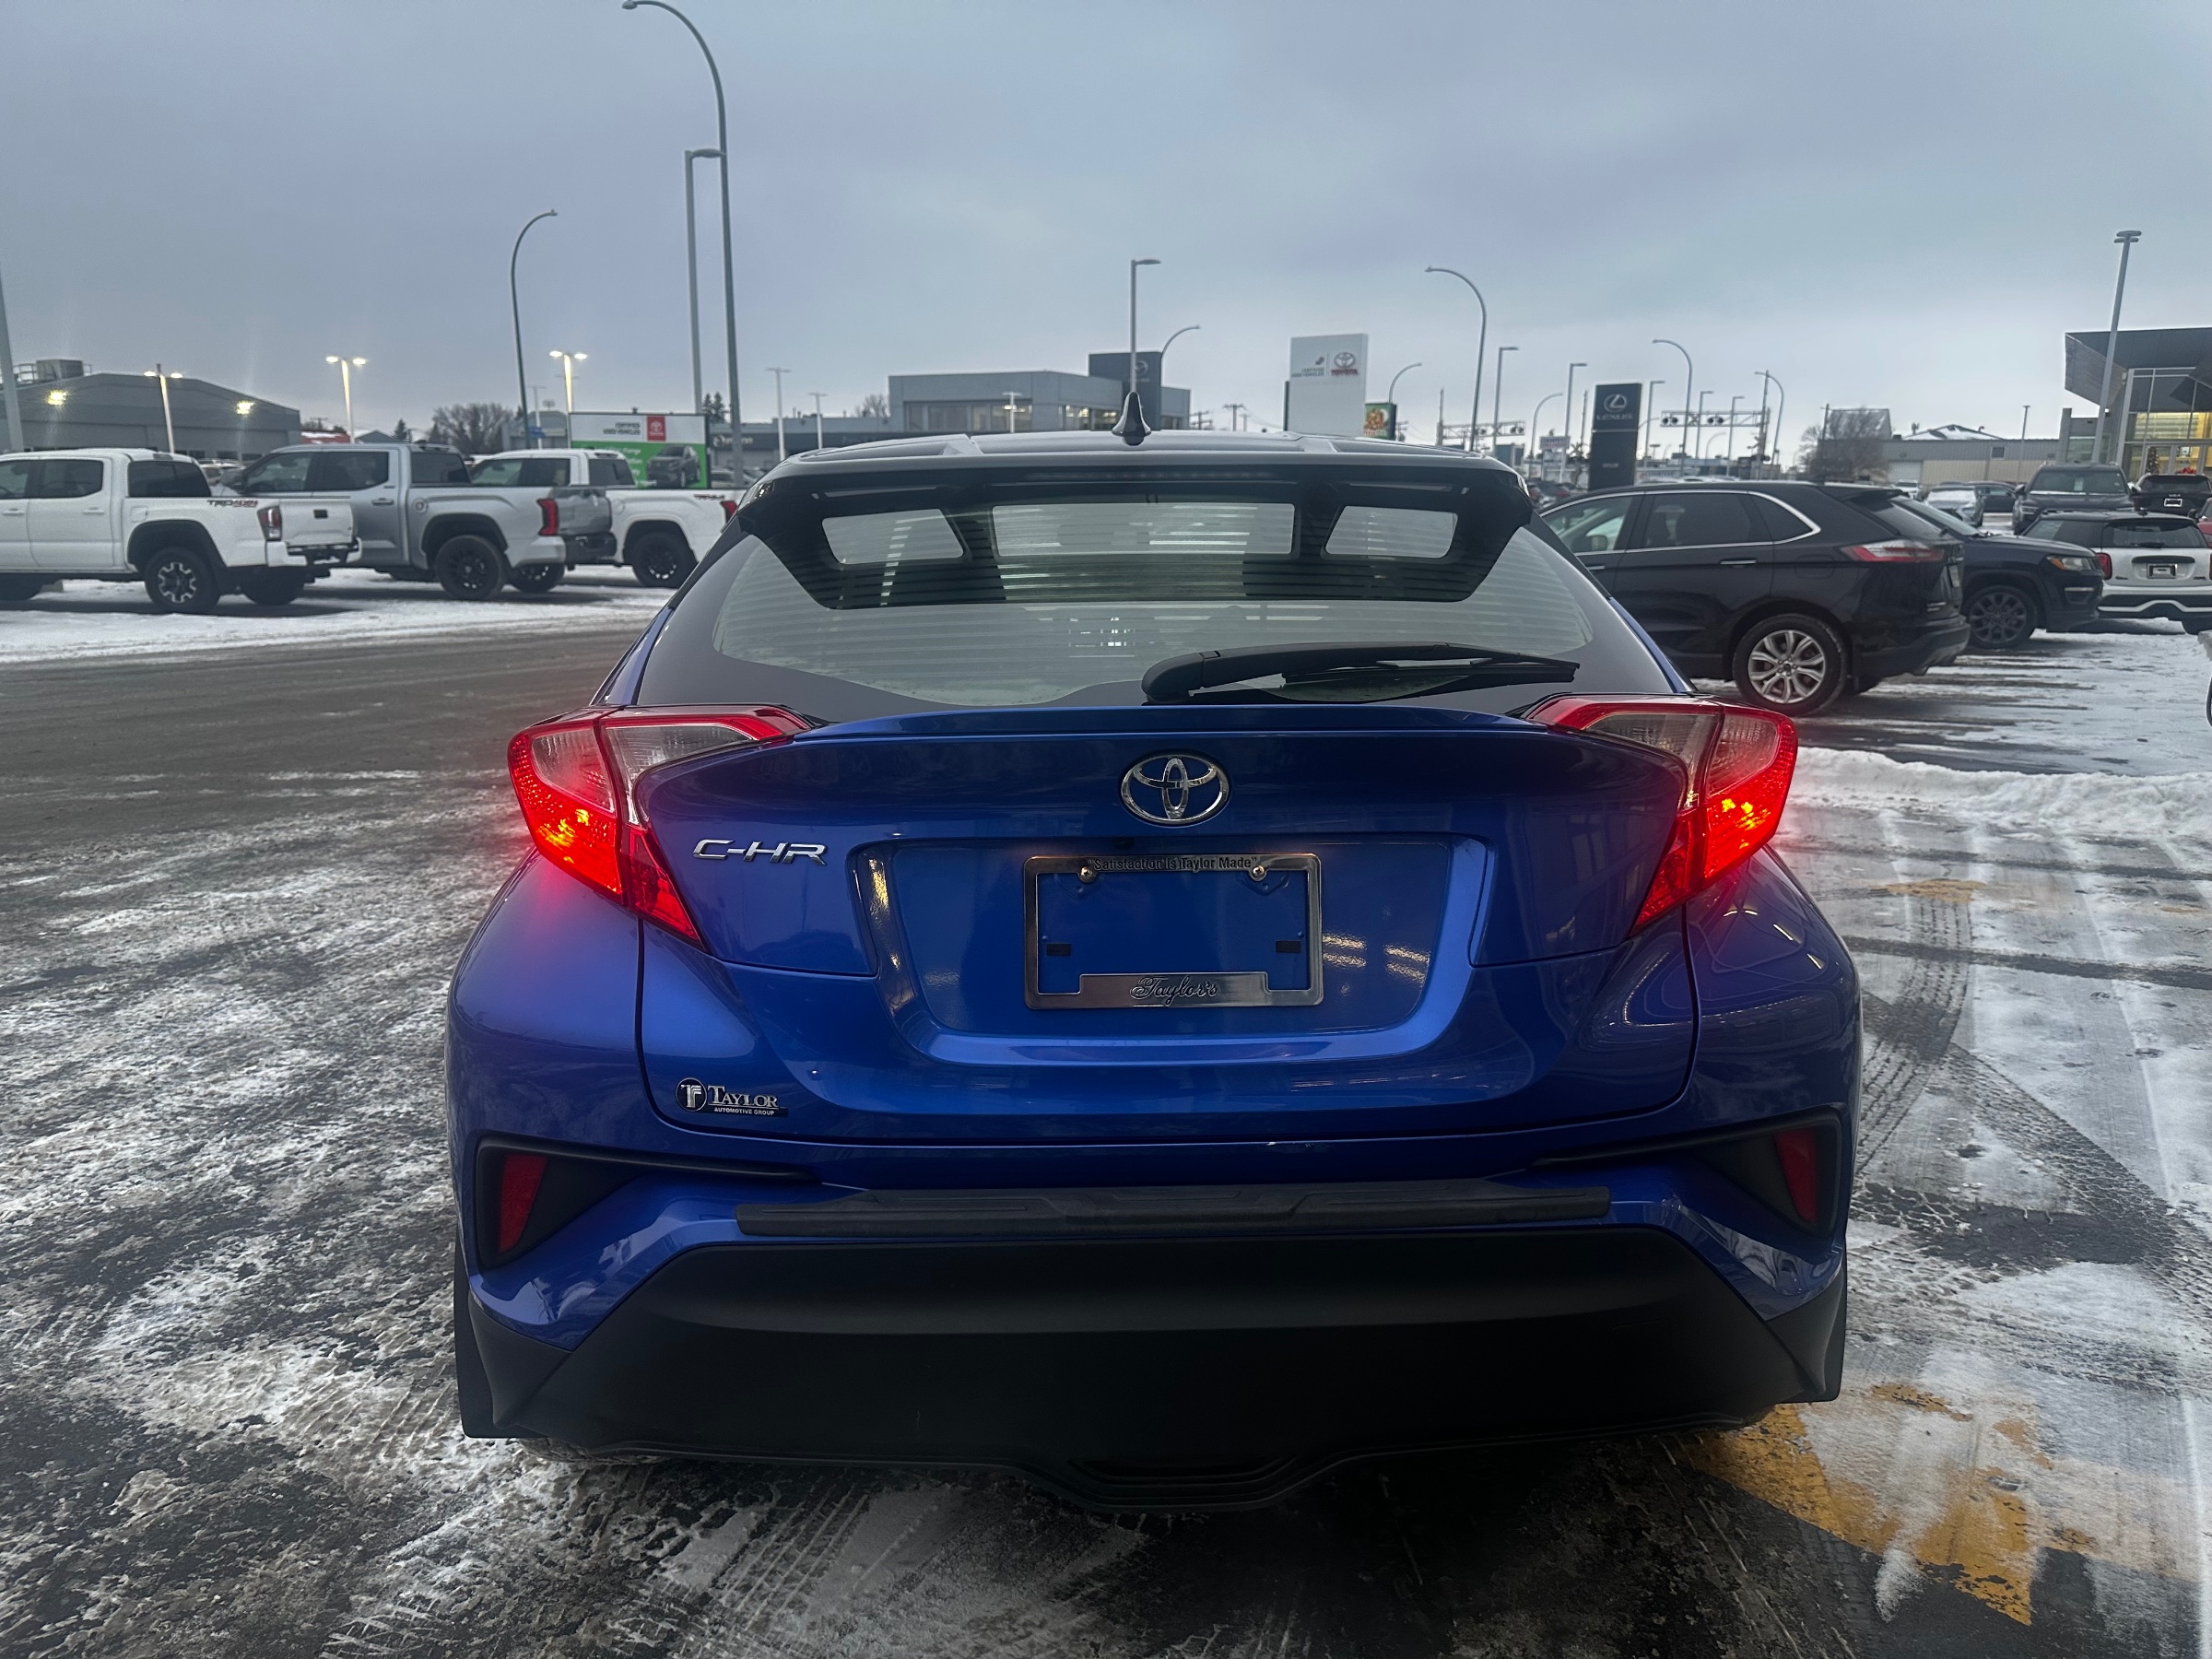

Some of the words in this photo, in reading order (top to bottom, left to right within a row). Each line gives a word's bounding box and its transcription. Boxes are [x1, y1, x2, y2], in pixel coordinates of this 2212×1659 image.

[692, 839, 828, 866] C-HR
[1179, 857, 1216, 873] Taylor
[1129, 974, 1218, 1006] Taylor's
[707, 1085, 779, 1108] TAYLOR
[713, 1107, 753, 1115] AUTOMOTIVE
